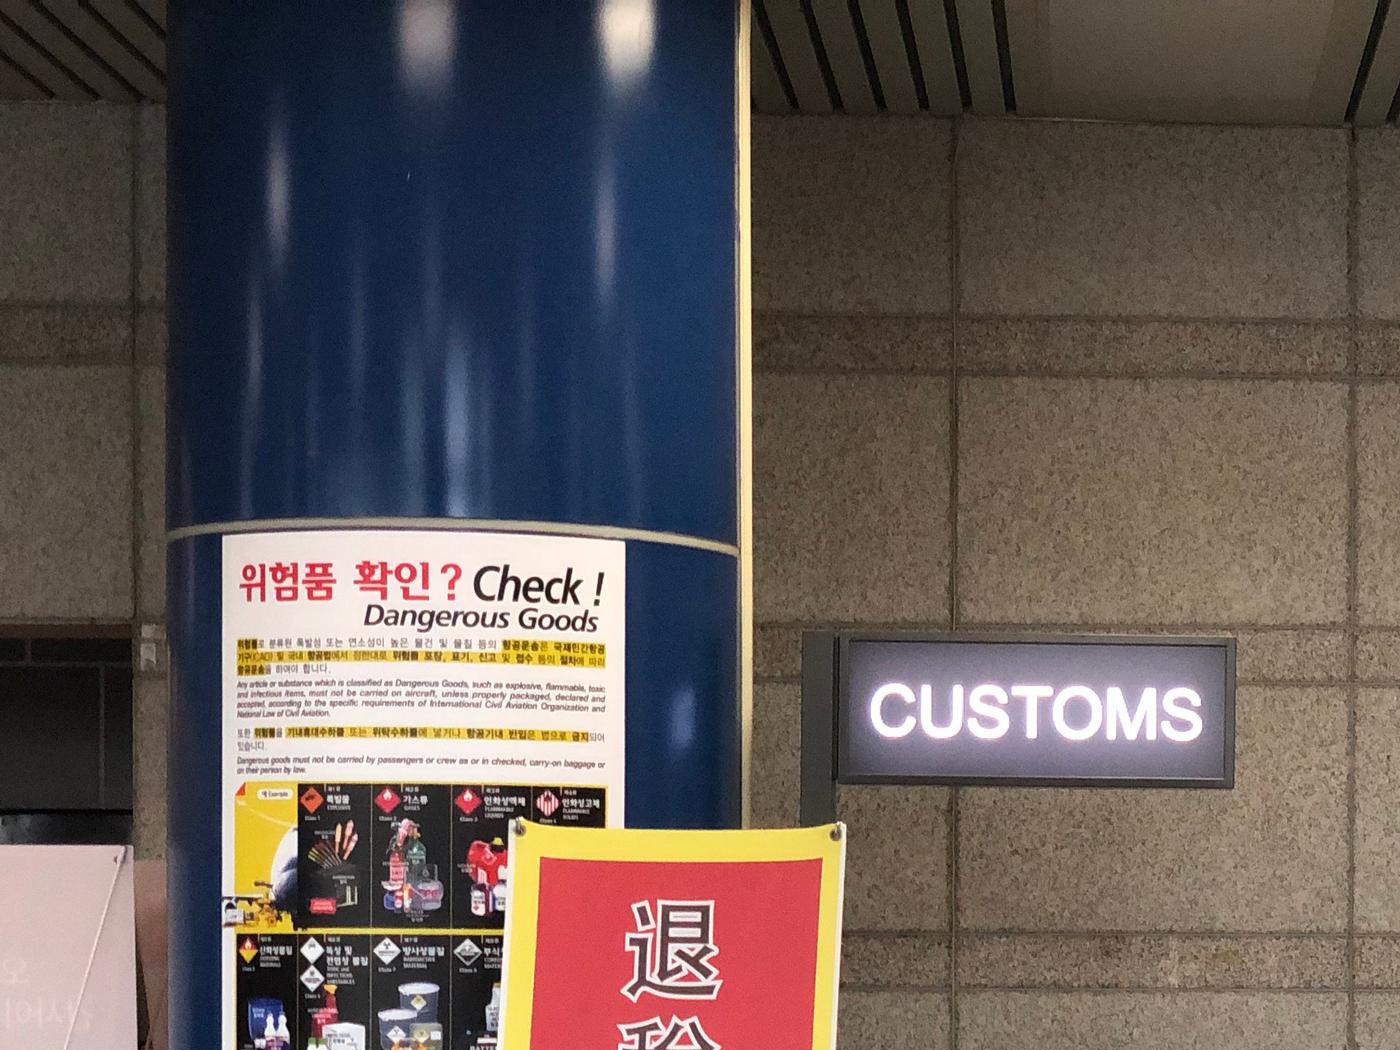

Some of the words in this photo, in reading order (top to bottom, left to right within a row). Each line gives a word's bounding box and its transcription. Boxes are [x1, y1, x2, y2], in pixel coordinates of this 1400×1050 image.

[239, 563, 337, 602] 위험품
[474, 565, 581, 606] Check
[364, 604, 510, 633] Dangerous
[518, 607, 599, 633] Goods
[361, 700, 414, 708] requirements
[418, 700, 481, 708] International
[485, 701, 502, 709] Civil
[506, 701, 537, 710] Aviation
[541, 703, 588, 712] Organization
[405, 690, 437, 698] aircraft,
[510, 693, 551, 701] packaged,
[556, 694, 588, 702] declared
[870, 683, 1202, 742] CUSTOMS
